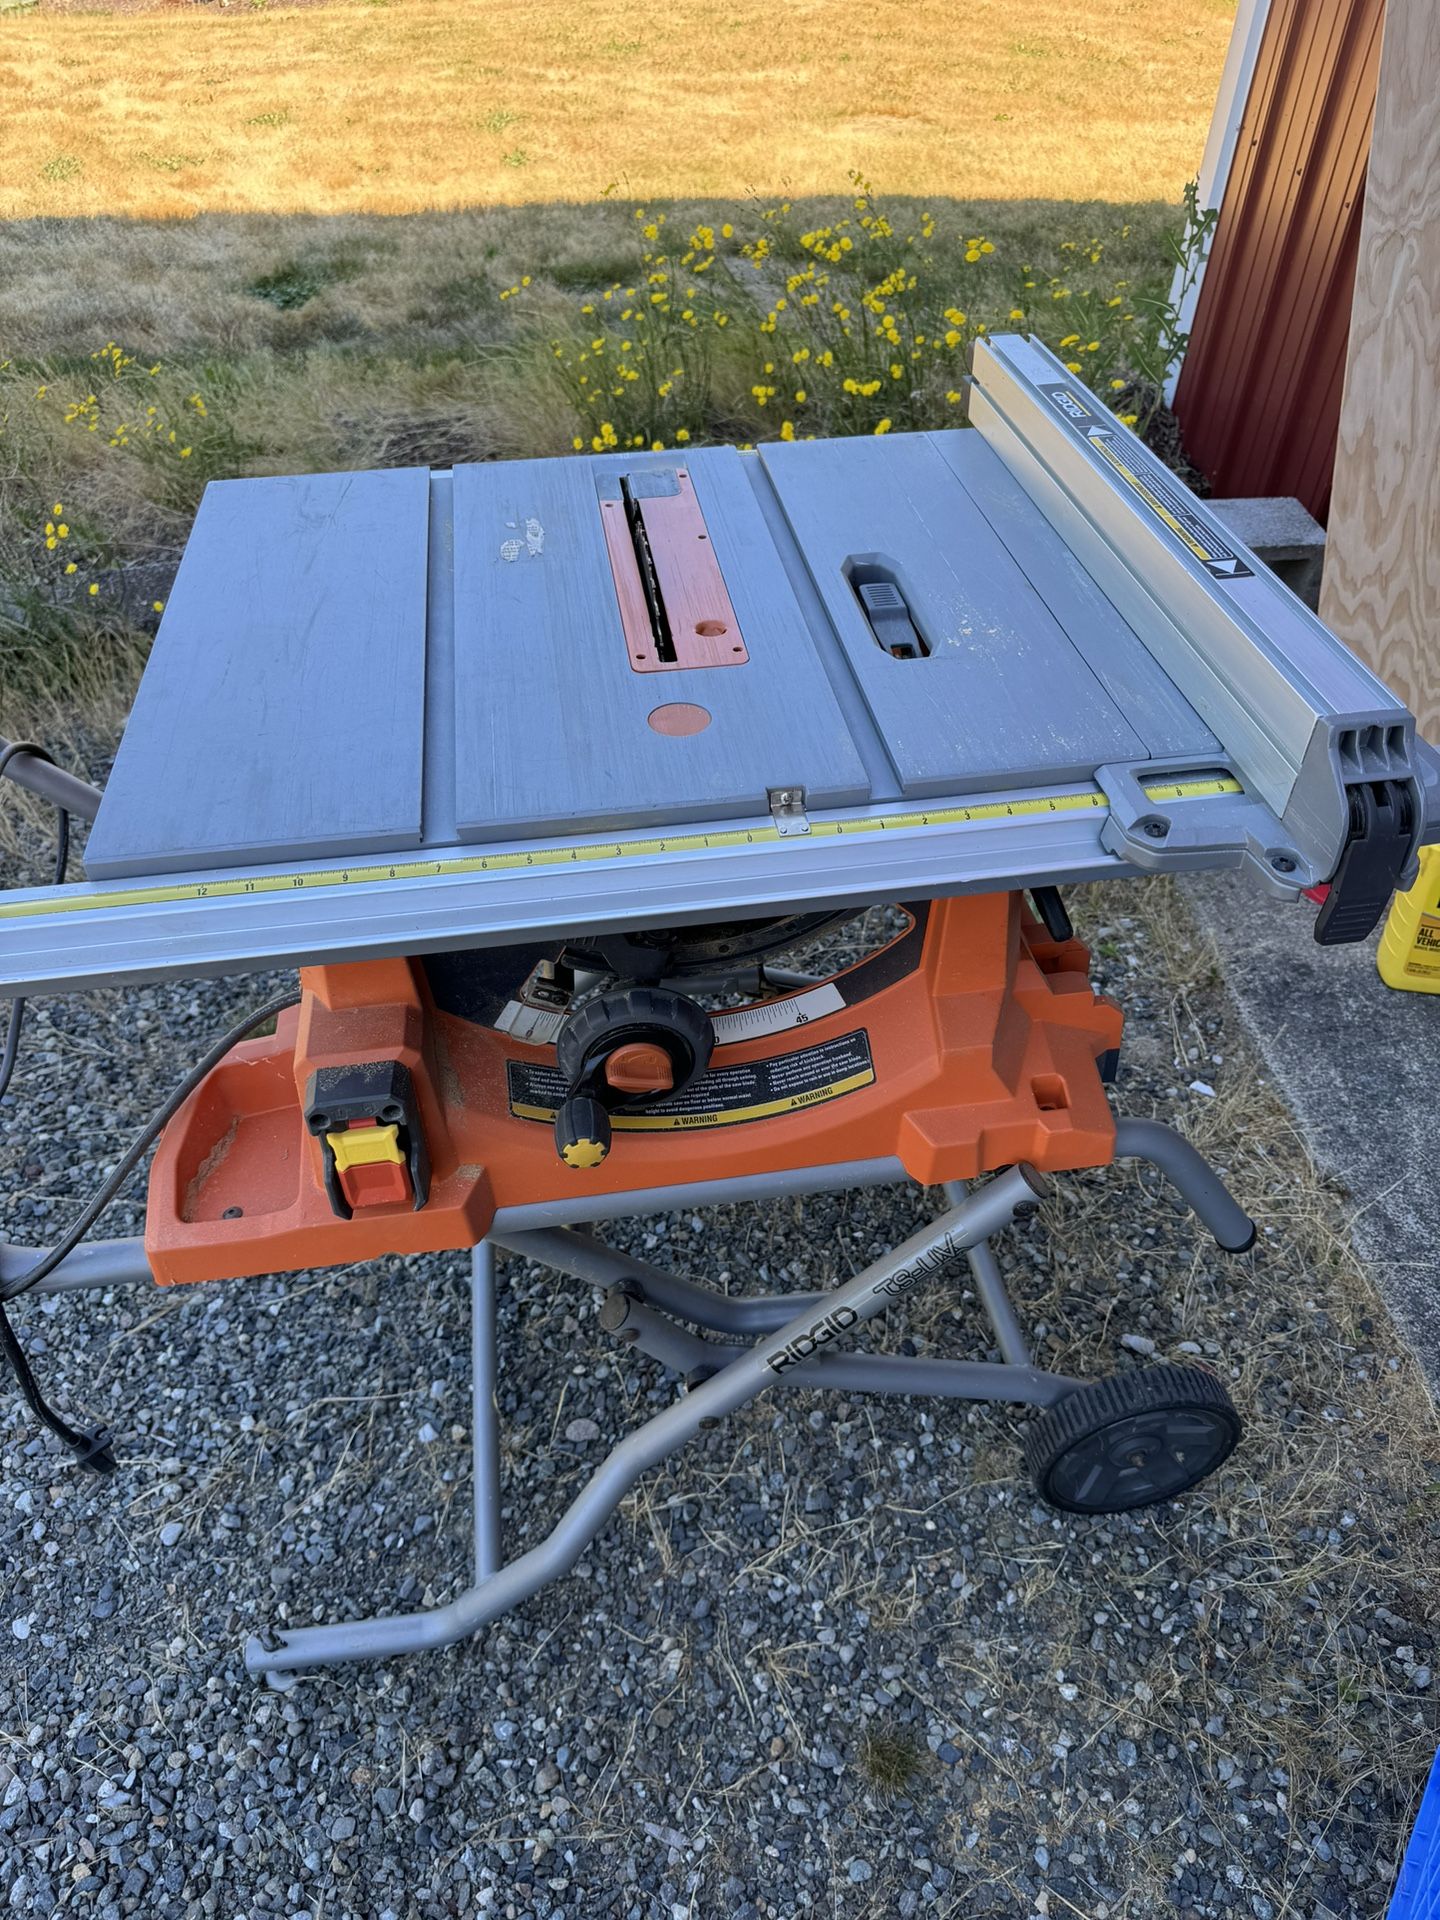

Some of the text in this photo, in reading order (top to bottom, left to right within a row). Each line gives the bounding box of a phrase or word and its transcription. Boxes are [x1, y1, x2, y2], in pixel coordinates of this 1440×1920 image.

[1051, 391, 1086, 418] RIDGID
[837, 783, 1225, 834] 0 1 2 3 4 5 6 8 9
[197, 834, 753, 896] 12 11 10 9 8 7 6 5 4 3 2 1 0
[1419, 928, 1433, 937] ALL
[796, 1014, 808, 1024] 45
[797, 1087, 833, 1104] WARNING
[681, 1114, 718, 1125] WARNING
[766, 1306, 859, 1375] RIDGID
